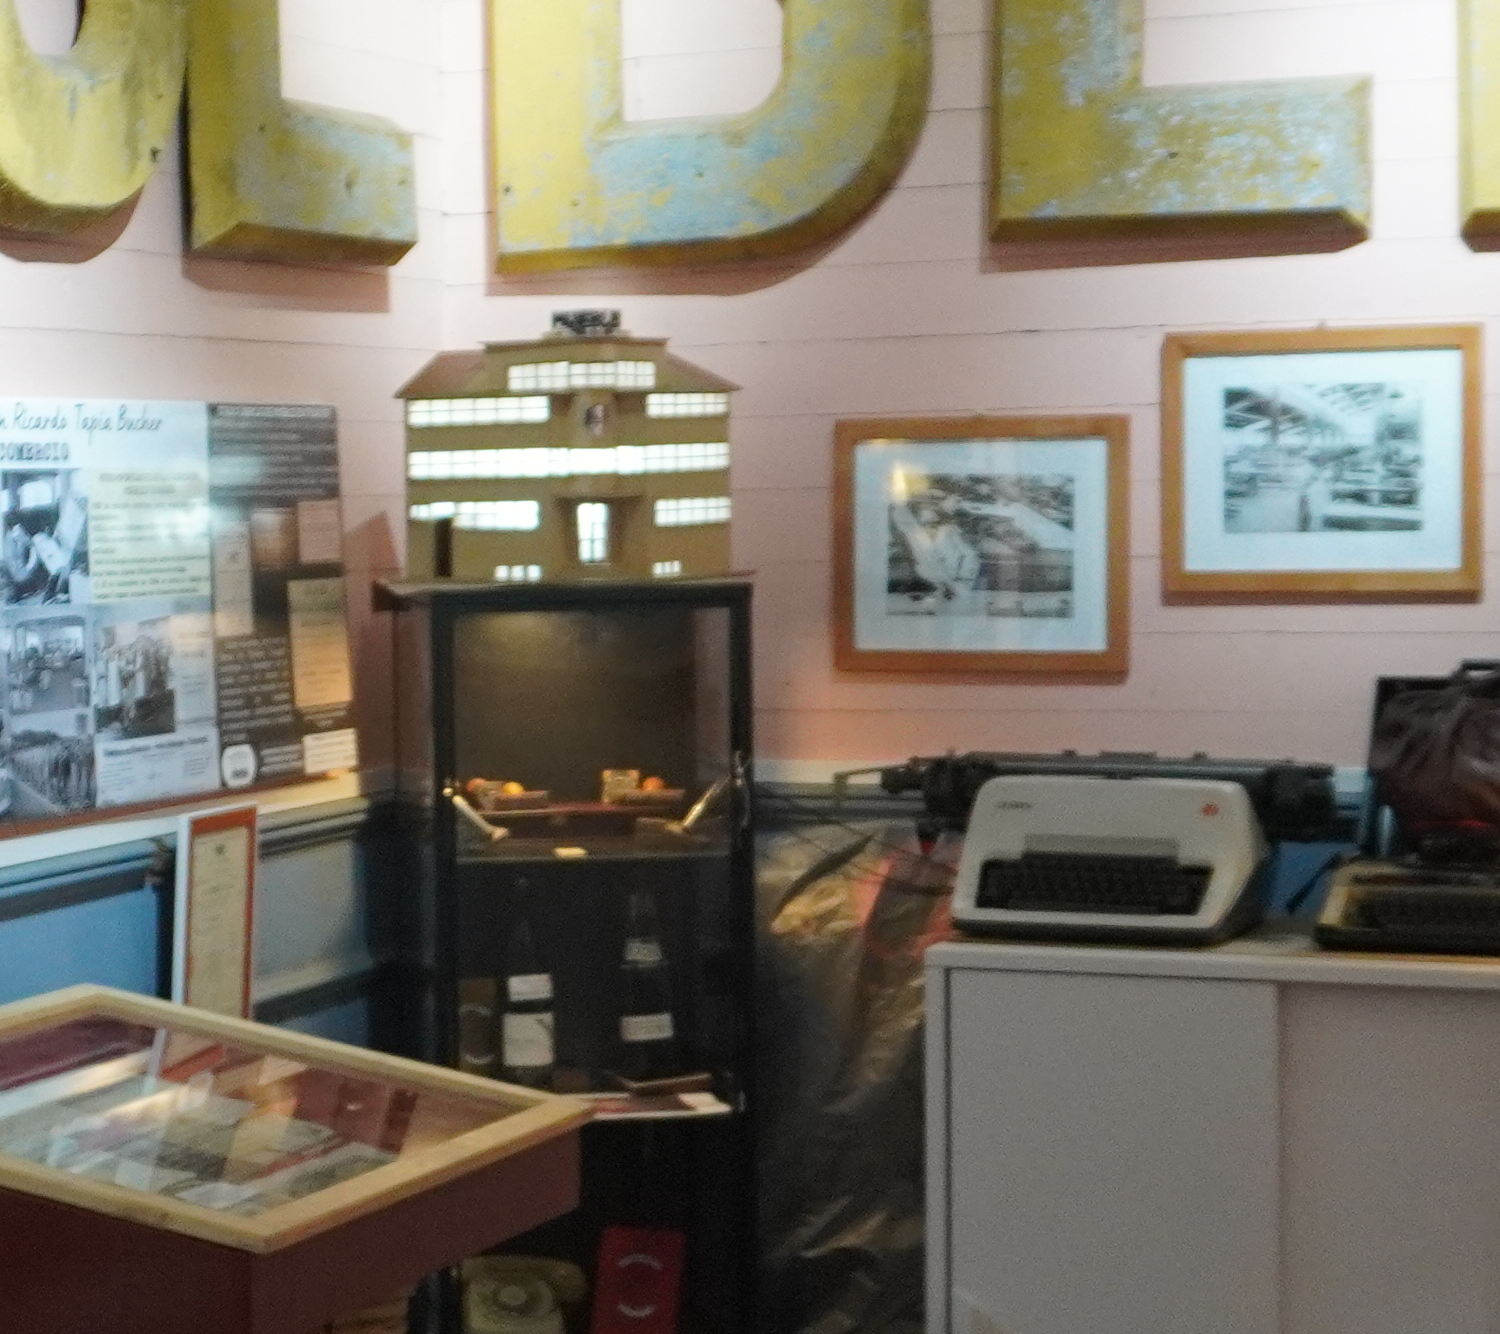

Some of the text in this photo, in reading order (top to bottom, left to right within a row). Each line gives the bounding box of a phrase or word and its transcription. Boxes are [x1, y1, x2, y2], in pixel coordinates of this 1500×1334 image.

[12, 401, 68, 432] Ricardo
[74, 402, 113, 445] Tapia
[115, 404, 164, 432] Bucher
